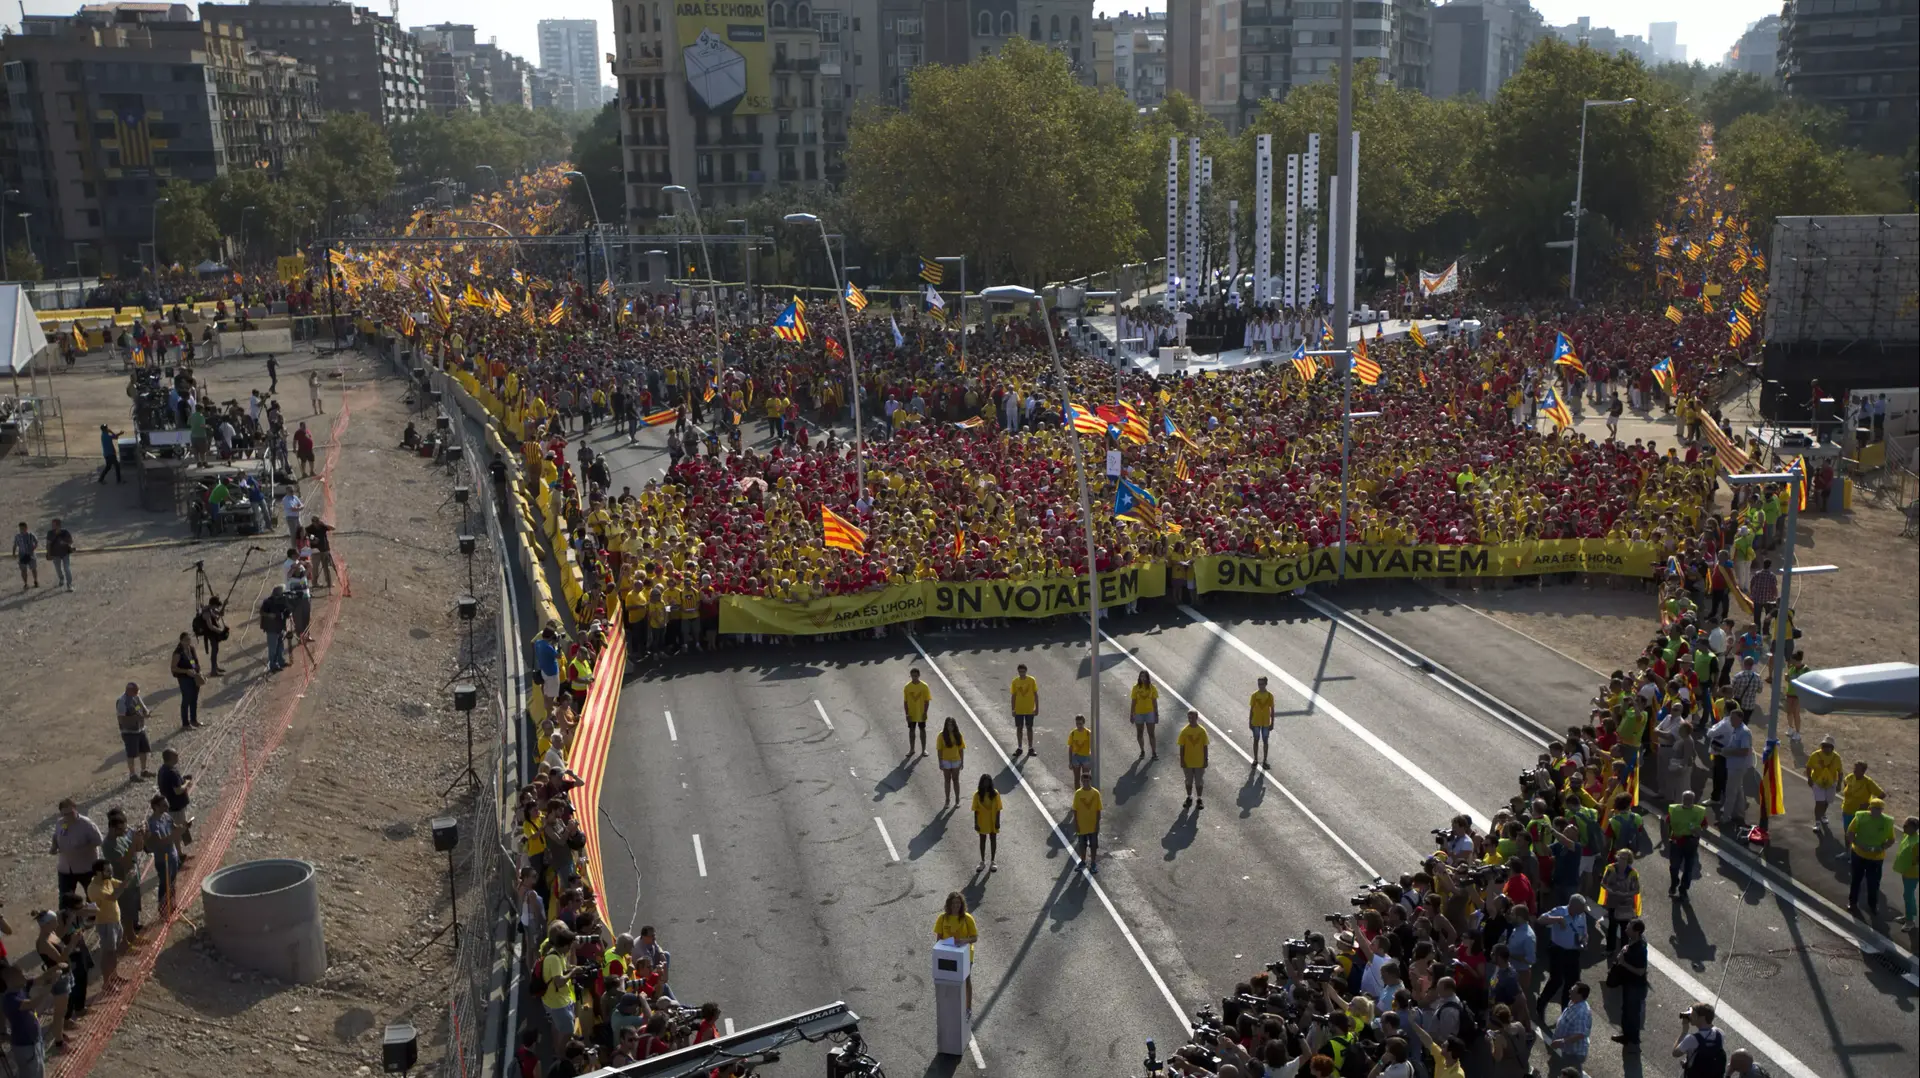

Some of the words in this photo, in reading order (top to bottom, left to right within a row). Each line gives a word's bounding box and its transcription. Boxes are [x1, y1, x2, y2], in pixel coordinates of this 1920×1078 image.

[677, 3, 702, 16] ARA
[1217, 558, 1262, 587] 9N
[1274, 549, 1488, 586] GUANYAREM
[1533, 555, 1560, 564] ARA
[1562, 552, 1576, 563] ÉS
[1579, 553, 1623, 565] L'HORA
[936, 586, 982, 613] 9N
[993, 568, 1139, 612] VOTAREM
[833, 609, 861, 622] ARA
[863, 602, 878, 617] ÉS
[881, 597, 924, 614] L'HORA
[798, 1006, 842, 1025] MUXART
